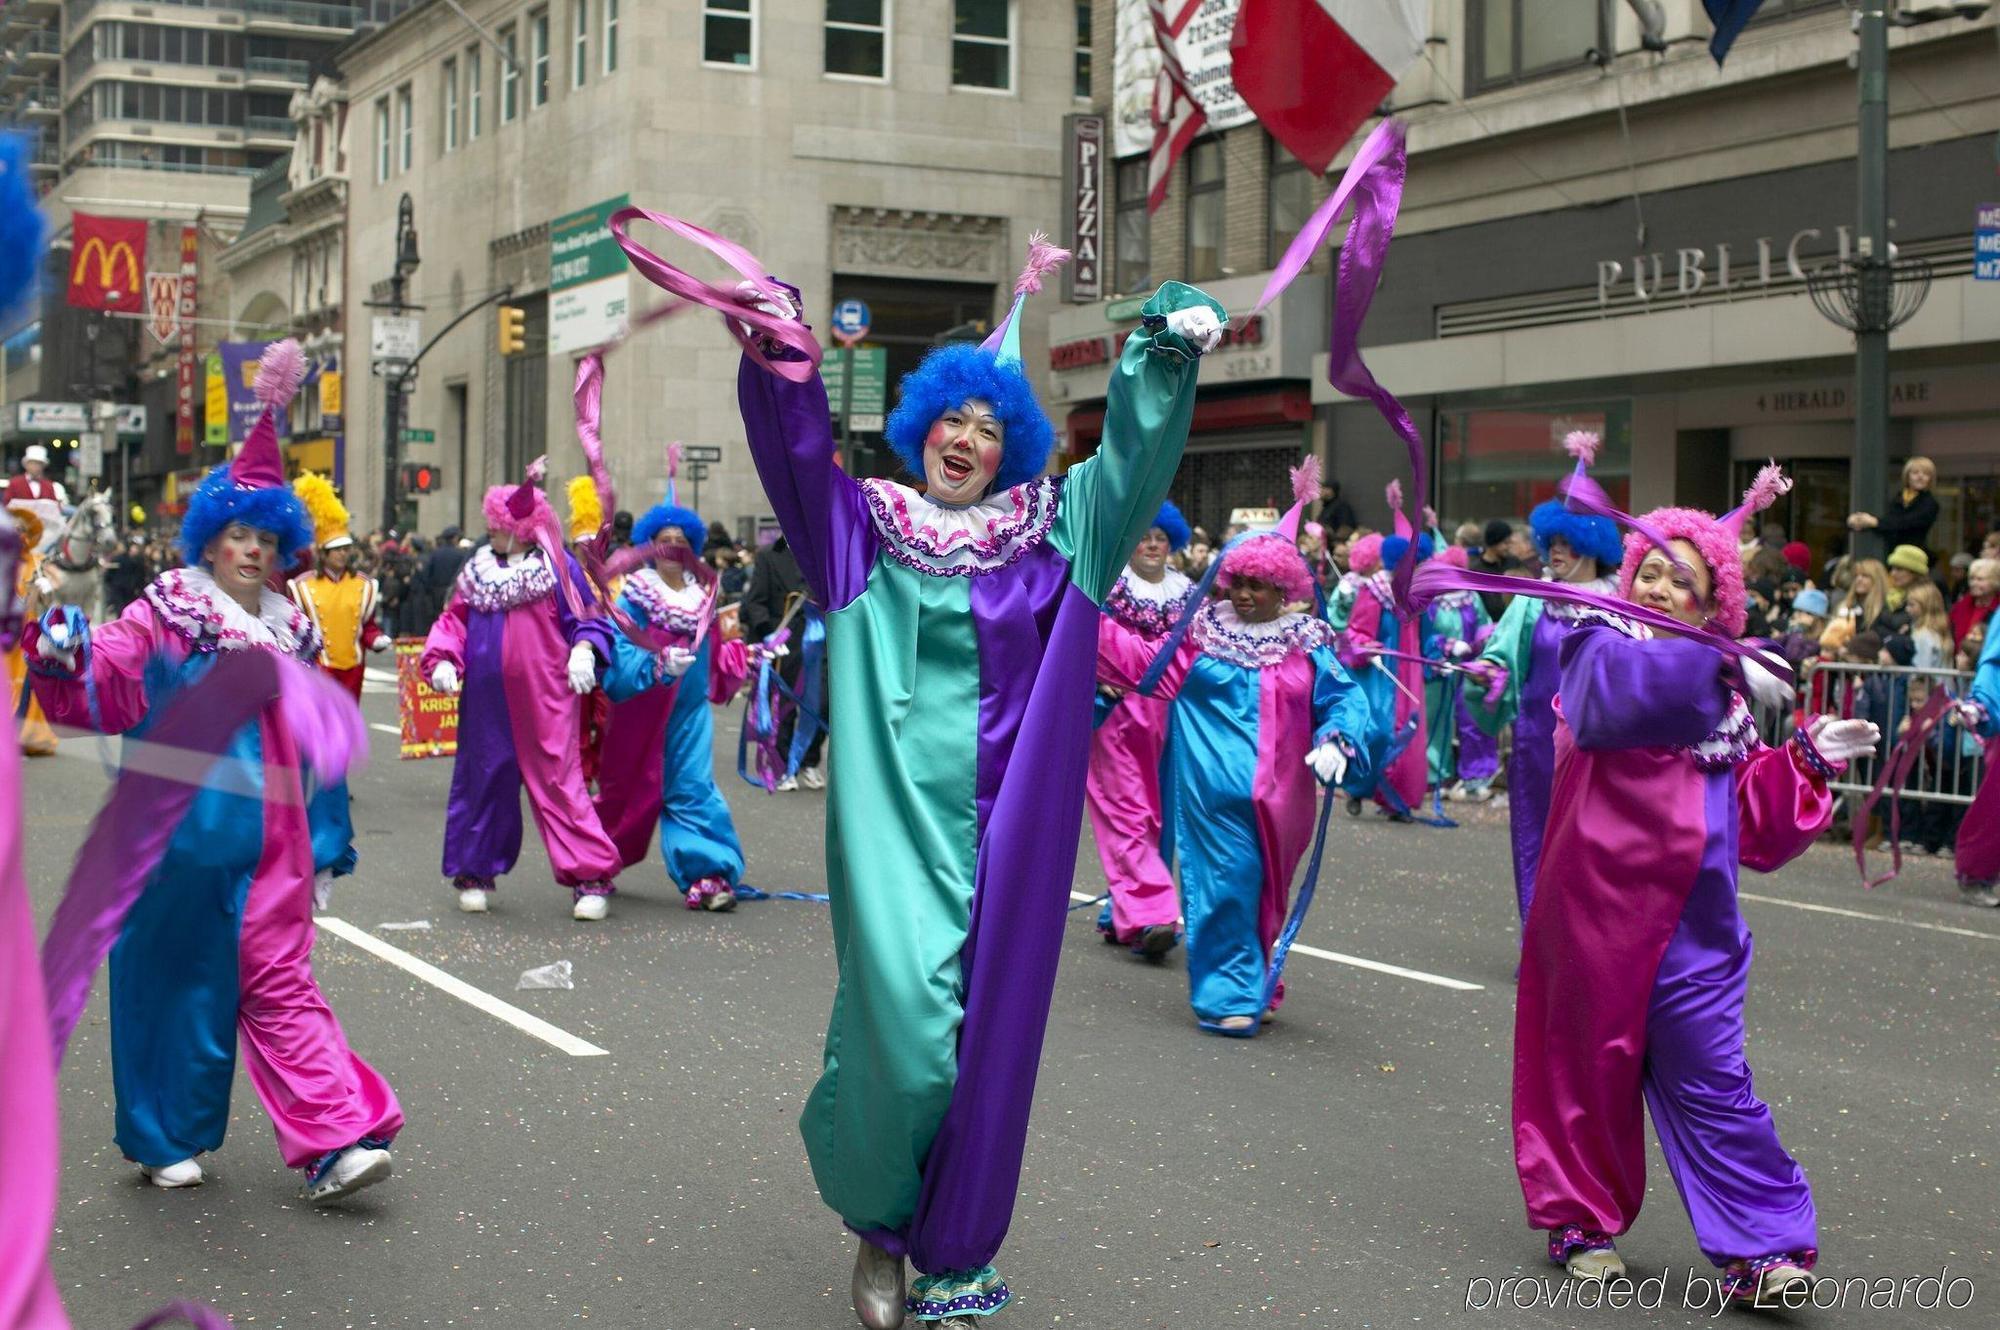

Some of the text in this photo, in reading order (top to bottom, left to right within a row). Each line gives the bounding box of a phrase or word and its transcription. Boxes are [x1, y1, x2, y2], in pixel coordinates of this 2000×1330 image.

[1077, 141, 1097, 260] PIZZA
[1598, 225, 1898, 304] PUBLICI
[1773, 388, 1845, 411] HERALD
[1240, 510, 1275, 519] ATM
